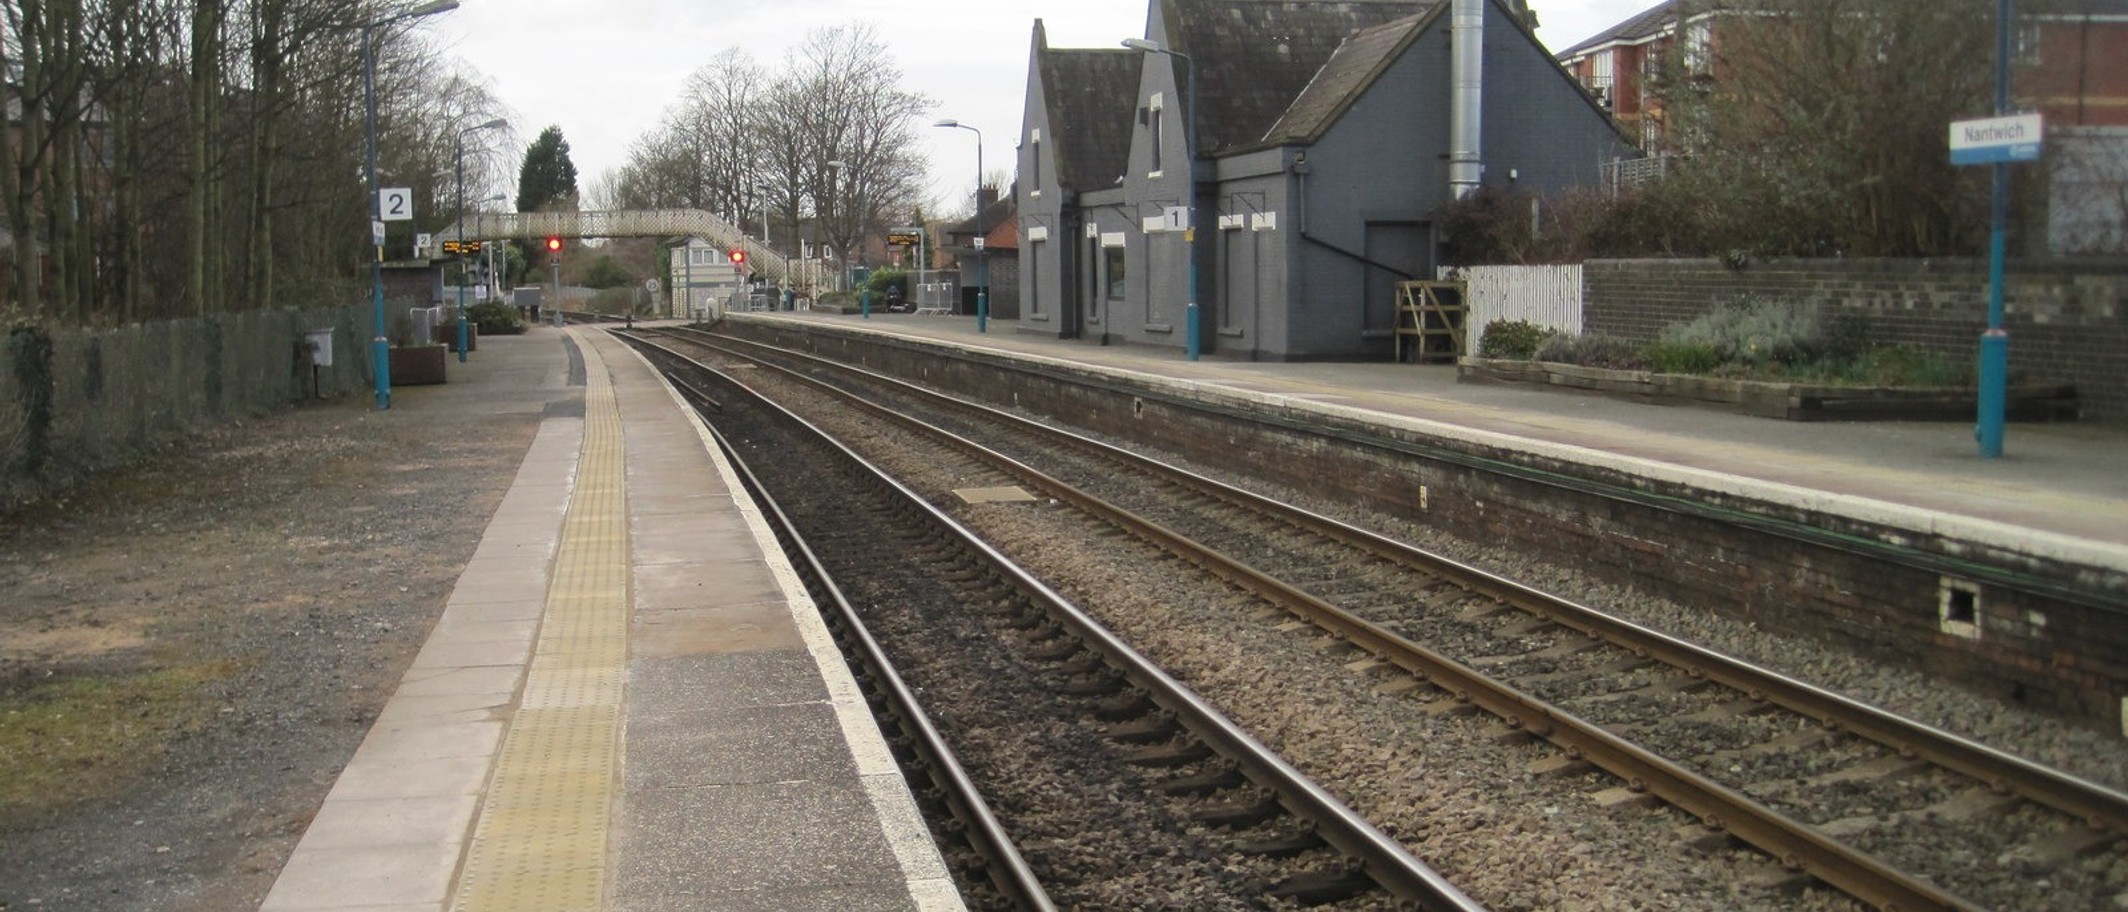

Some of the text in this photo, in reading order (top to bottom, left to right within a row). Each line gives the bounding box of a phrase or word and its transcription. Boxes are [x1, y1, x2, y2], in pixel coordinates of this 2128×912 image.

[1964, 121, 2024, 142] Nantwich
[388, 193, 404, 215] 2
[1171, 210, 1178, 227] 1
[421, 236, 427, 245] 2
